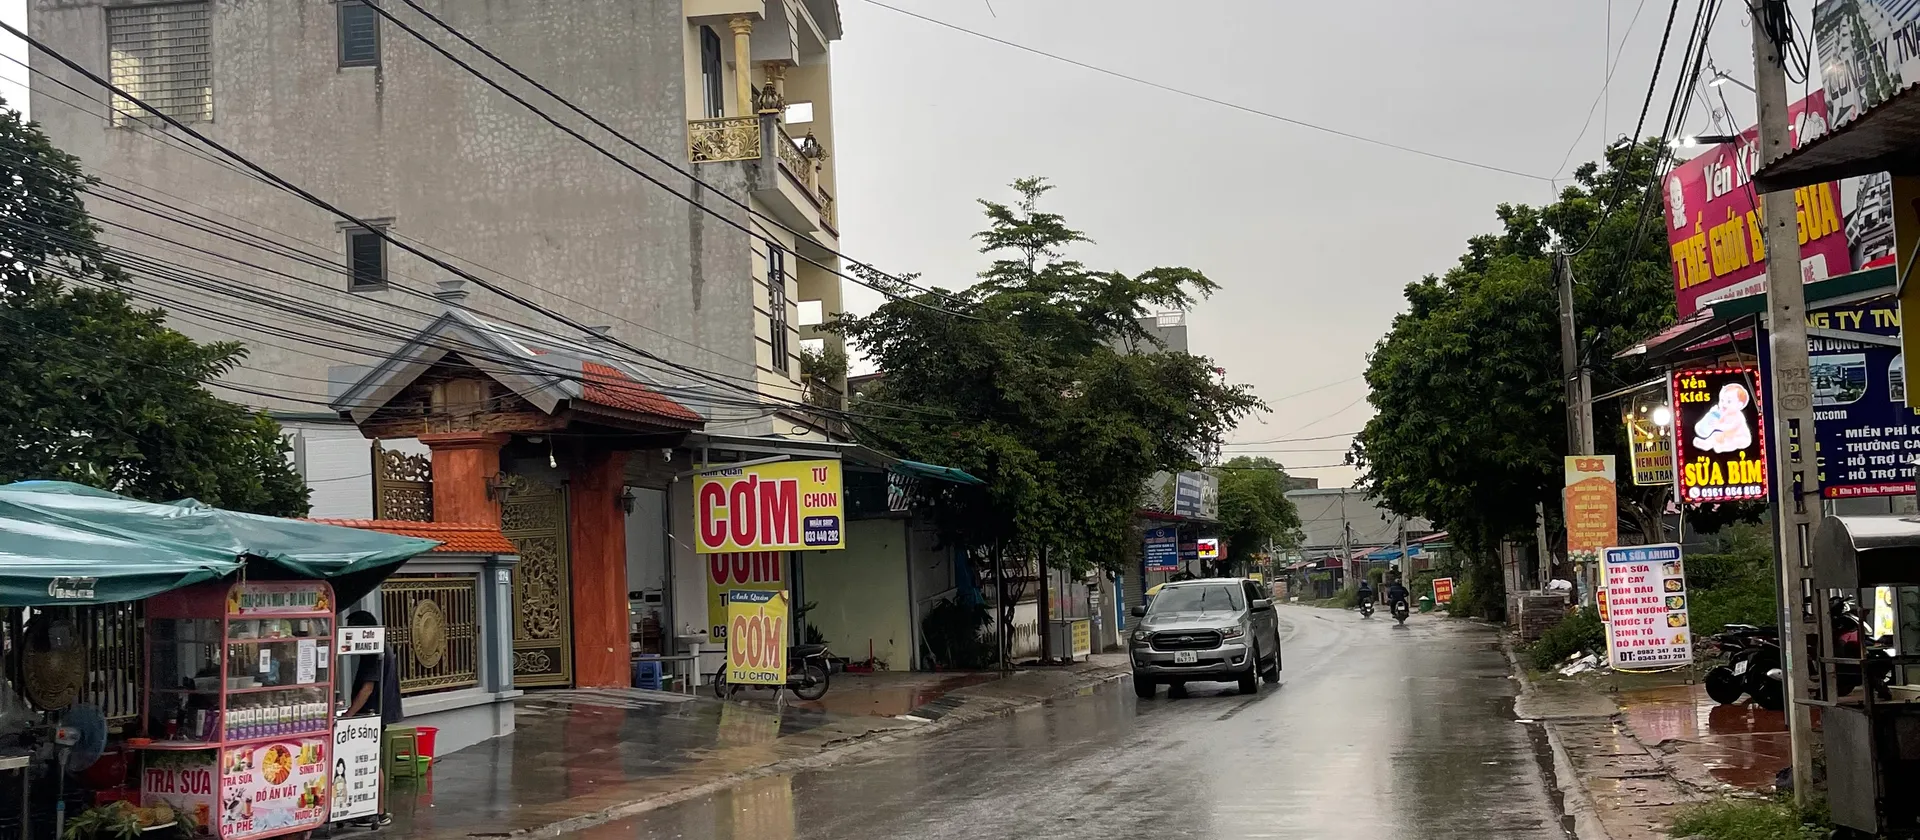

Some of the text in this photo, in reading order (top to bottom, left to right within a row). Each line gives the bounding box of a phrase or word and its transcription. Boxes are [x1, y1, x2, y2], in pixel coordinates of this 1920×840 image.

[1672, 211, 1711, 290] THẾ
[1835, 310, 1864, 330] TY
[1870, 309, 1901, 328] TN
[1681, 375, 1706, 389] Yến
[1680, 392, 1711, 402] Kids
[1845, 425, 1881, 438] MIỄN
[1884, 424, 1907, 436] PHÍ
[1846, 438, 1900, 452] THƯỞNG
[1847, 453, 1866, 466] HỖ
[1869, 453, 1895, 466] TRỢ
[812, 466, 828, 485] TỰ
[1685, 456, 1725, 486] SỮA
[1727, 451, 1763, 484] BỈM
[1848, 467, 1867, 480] HỖ
[1870, 467, 1896, 480] TRỢ
[1638, 471, 1654, 481] NHA
[700, 474, 799, 548] CƠM
[1628, 576, 1645, 584] CAY
[1613, 607, 1634, 616] NEM
[732, 606, 782, 669] CƠM
[1615, 629, 1638, 637] SINH
[336, 723, 379, 745] cafe sáng
[299, 765, 314, 776] SINH
